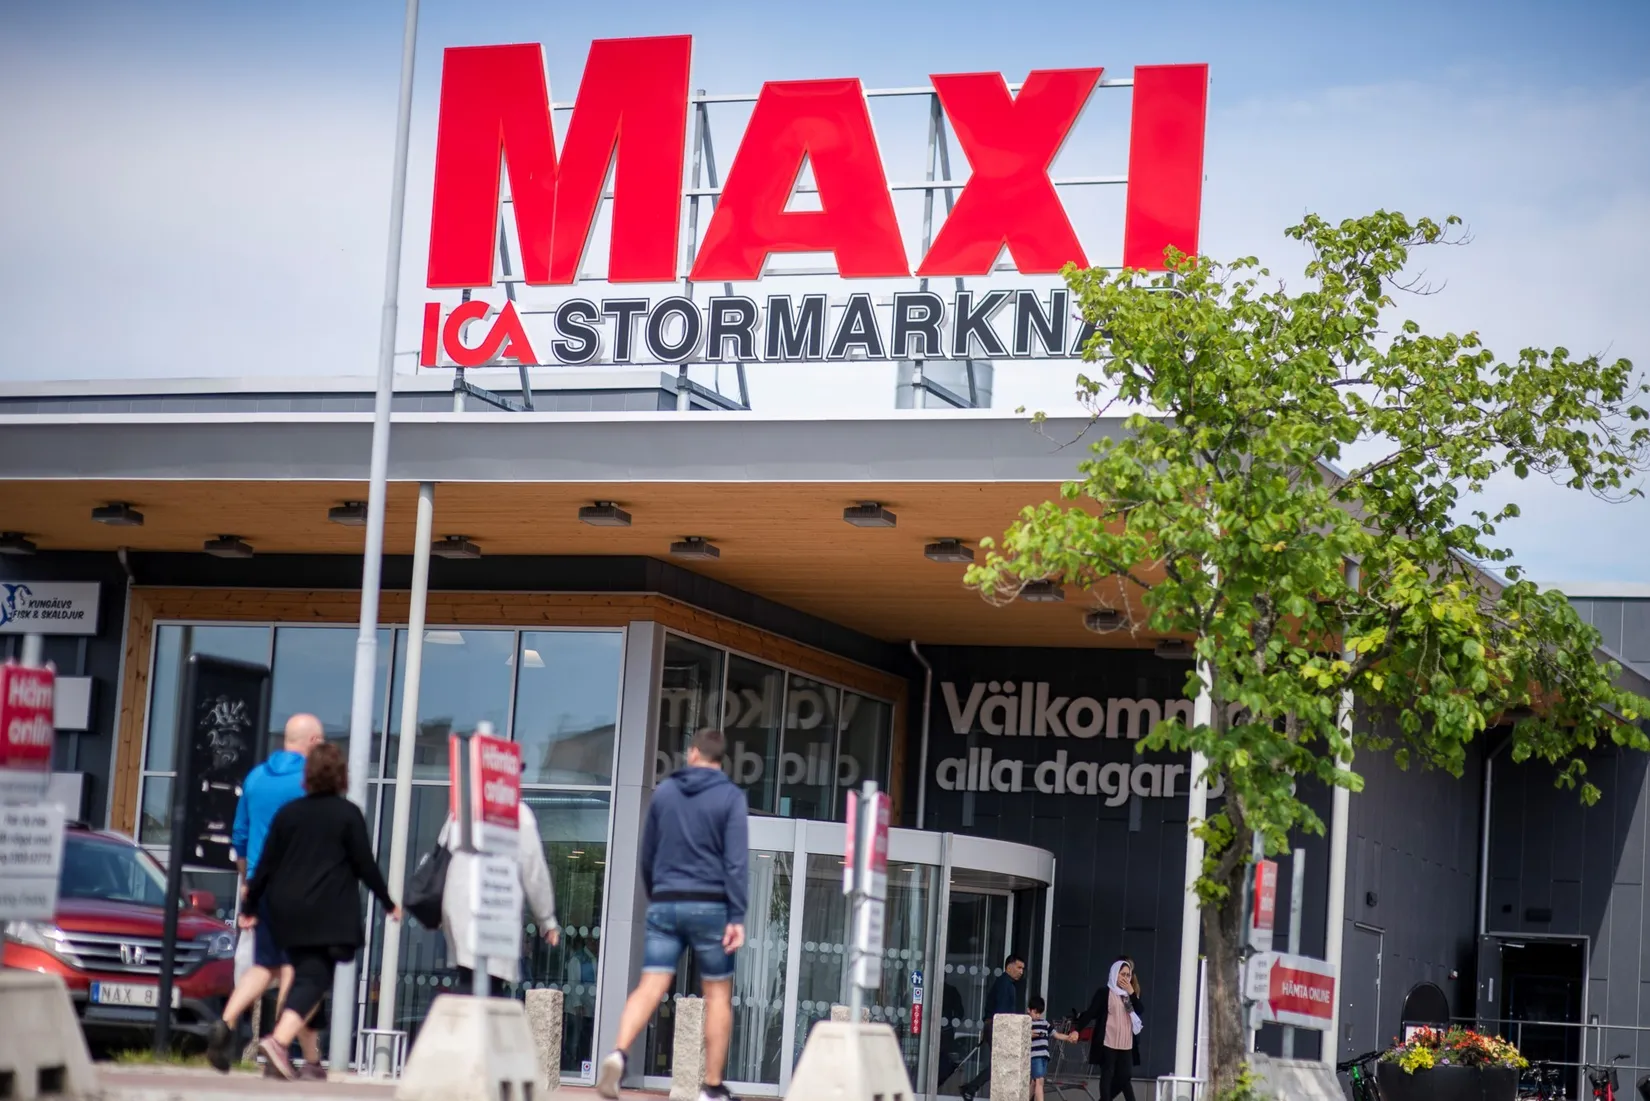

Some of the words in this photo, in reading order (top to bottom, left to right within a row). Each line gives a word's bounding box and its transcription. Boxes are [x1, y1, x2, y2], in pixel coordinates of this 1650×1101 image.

[426, 34, 1209, 288] MAXI
[420, 298, 539, 368] ICA
[550, 287, 1188, 365] STORMARKN
[13, 610, 31, 619] FISK
[40, 610, 84, 620] SKALDJUR
[28, 597, 72, 609] KUNGÄLVS
[935, 747, 1023, 792] alla
[1034, 749, 1184, 807] dagar
[1282, 979, 1308, 1000] HÄMTA
[1309, 986, 1331, 1004] ONLINE
